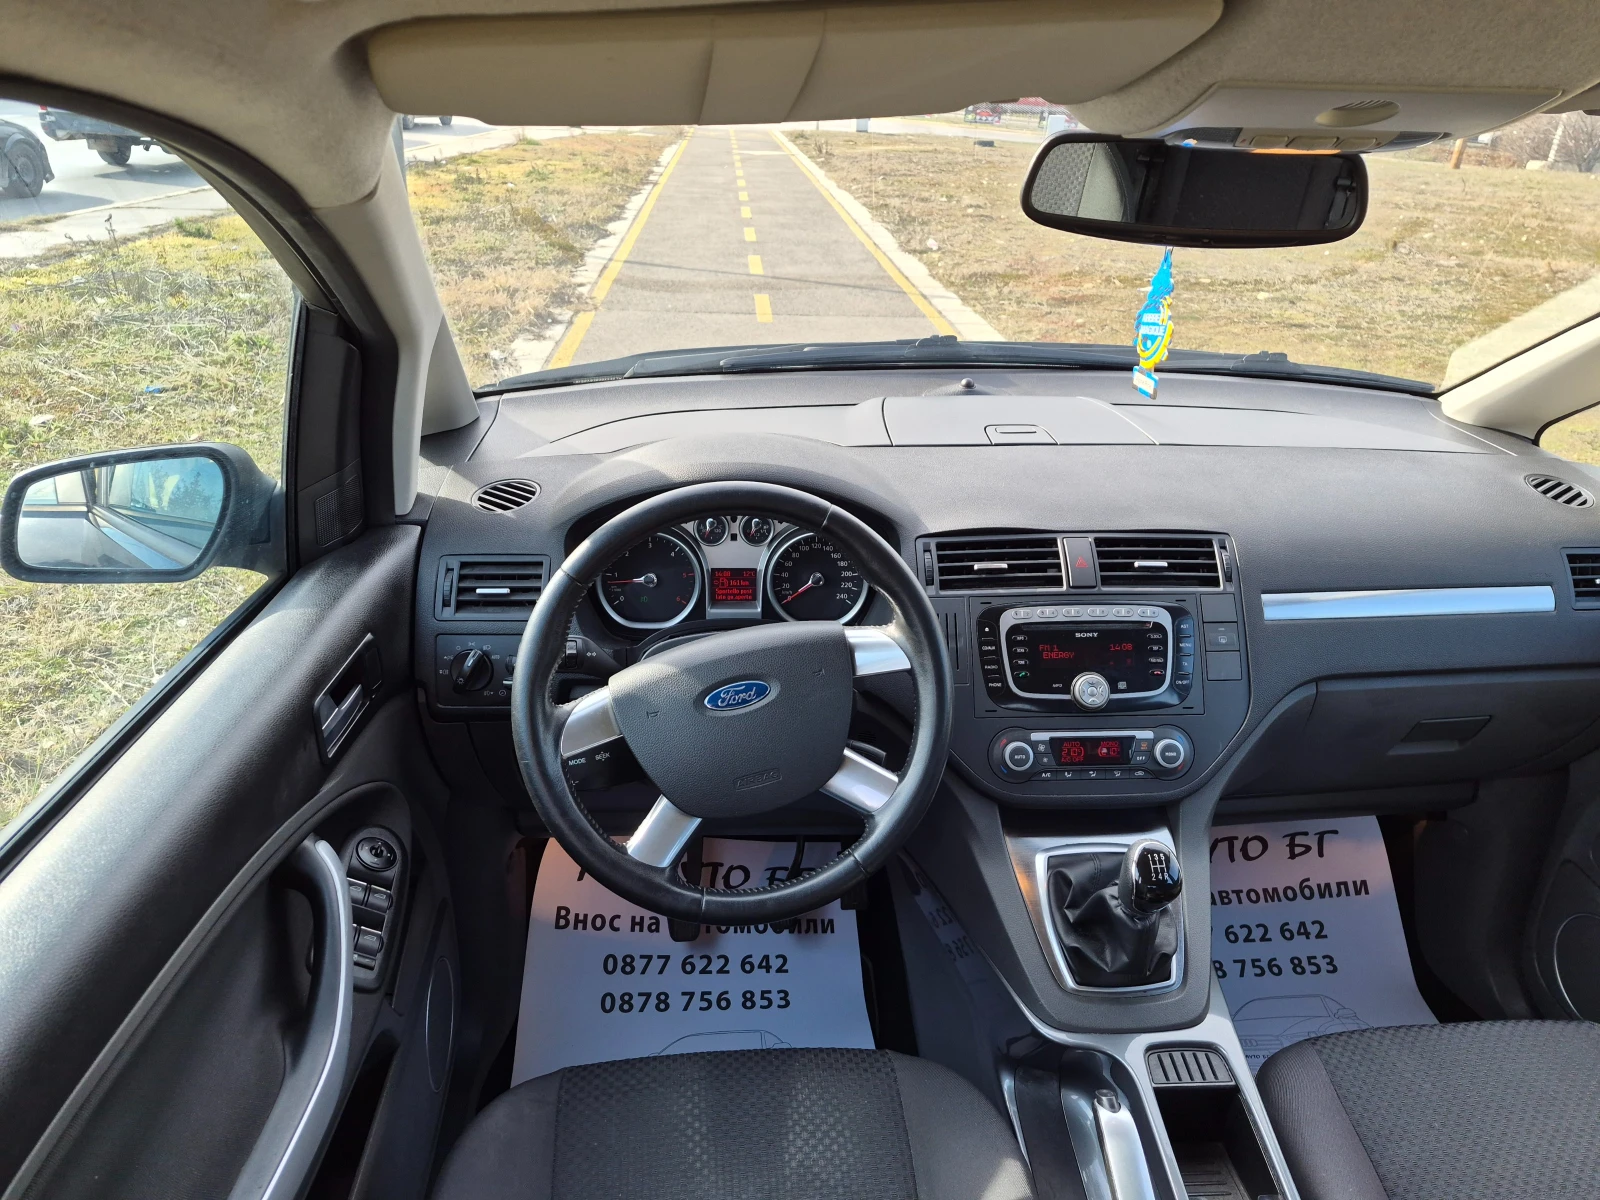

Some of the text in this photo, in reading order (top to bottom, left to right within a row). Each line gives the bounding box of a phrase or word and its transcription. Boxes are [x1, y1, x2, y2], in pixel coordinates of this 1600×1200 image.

[1043, 651, 1075, 659] ENERGY
[717, 685, 757, 707] Ford
[568, 757, 587, 766] MODE
[554, 906, 621, 932] Внос
[630, 913, 661, 934] на
[1224, 922, 1272, 944] 622
[1279, 920, 1328, 941] 642
[602, 954, 789, 975] 0877 622 642
[1233, 958, 1283, 978] 756
[1291, 954, 1338, 976] 853
[600, 989, 791, 1014] 0878 756 853
